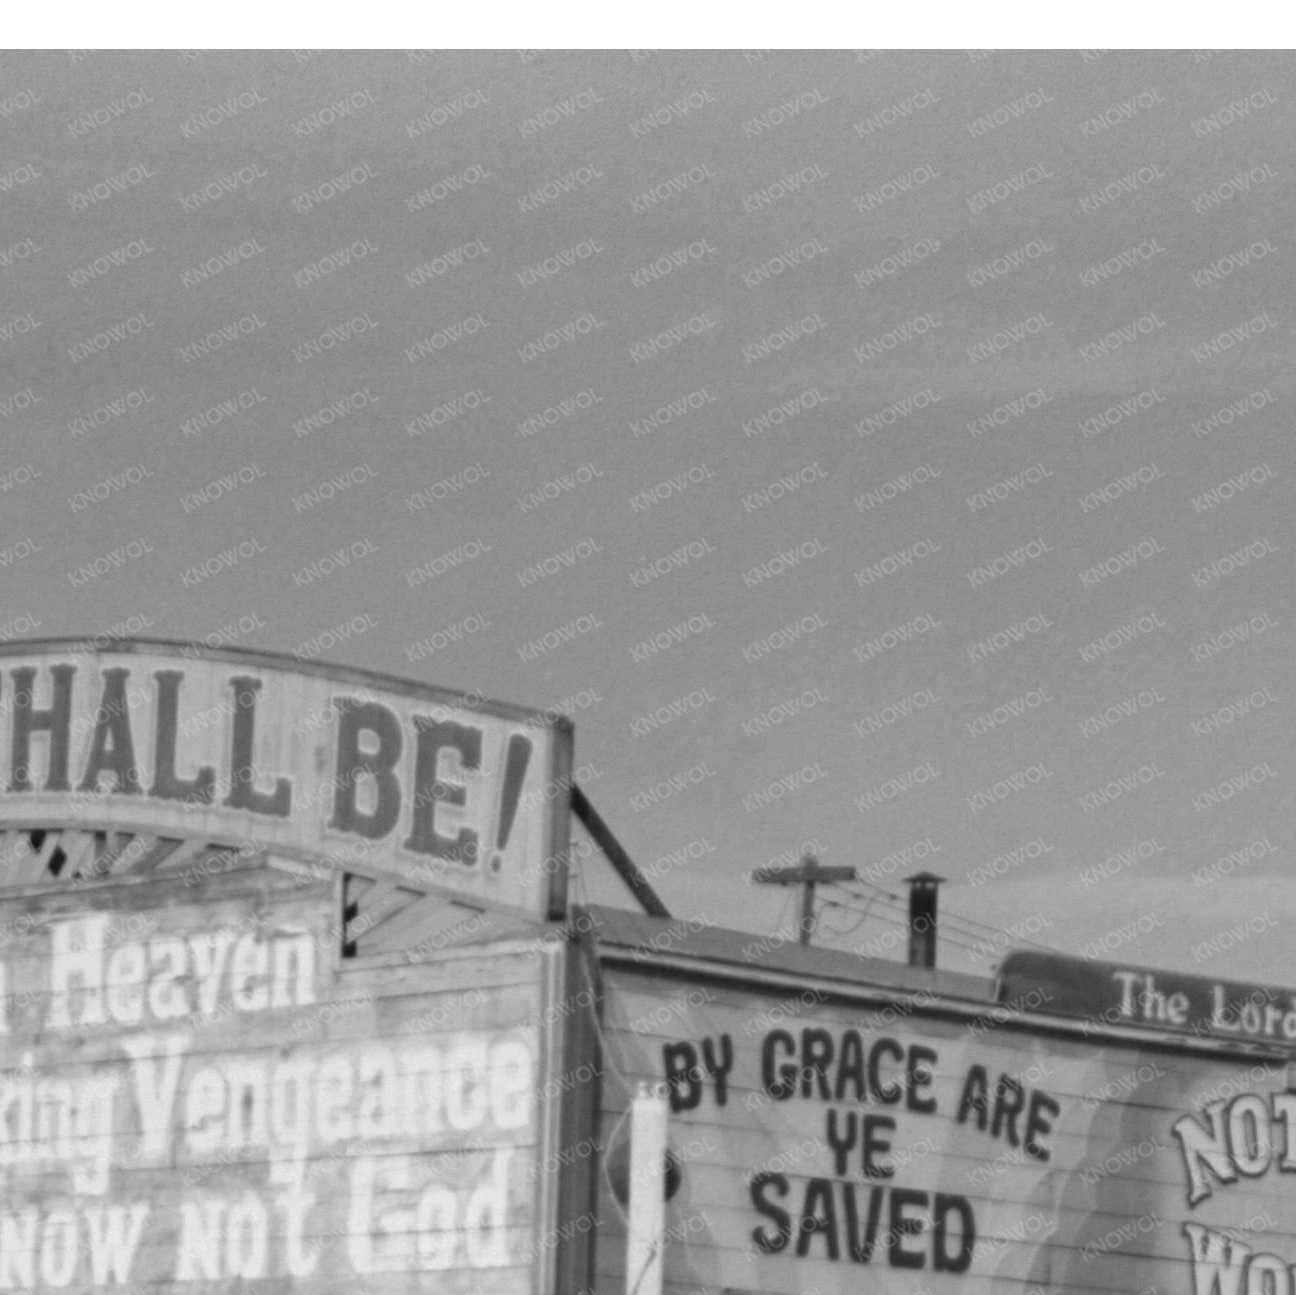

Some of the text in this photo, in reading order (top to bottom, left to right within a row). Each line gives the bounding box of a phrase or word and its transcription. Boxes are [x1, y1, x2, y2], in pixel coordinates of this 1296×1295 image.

[327, 697, 533, 872] BE!
[47, 912, 314, 1031] Heaven
[1112, 971, 1189, 1025] The
[122, 1034, 532, 1183] Vengeance
[663, 1027, 1061, 1162] BY GRACE ARE
[826, 1107, 897, 1178] YE
[347, 1148, 514, 1274] God
[750, 1171, 976, 1273] SAVED
